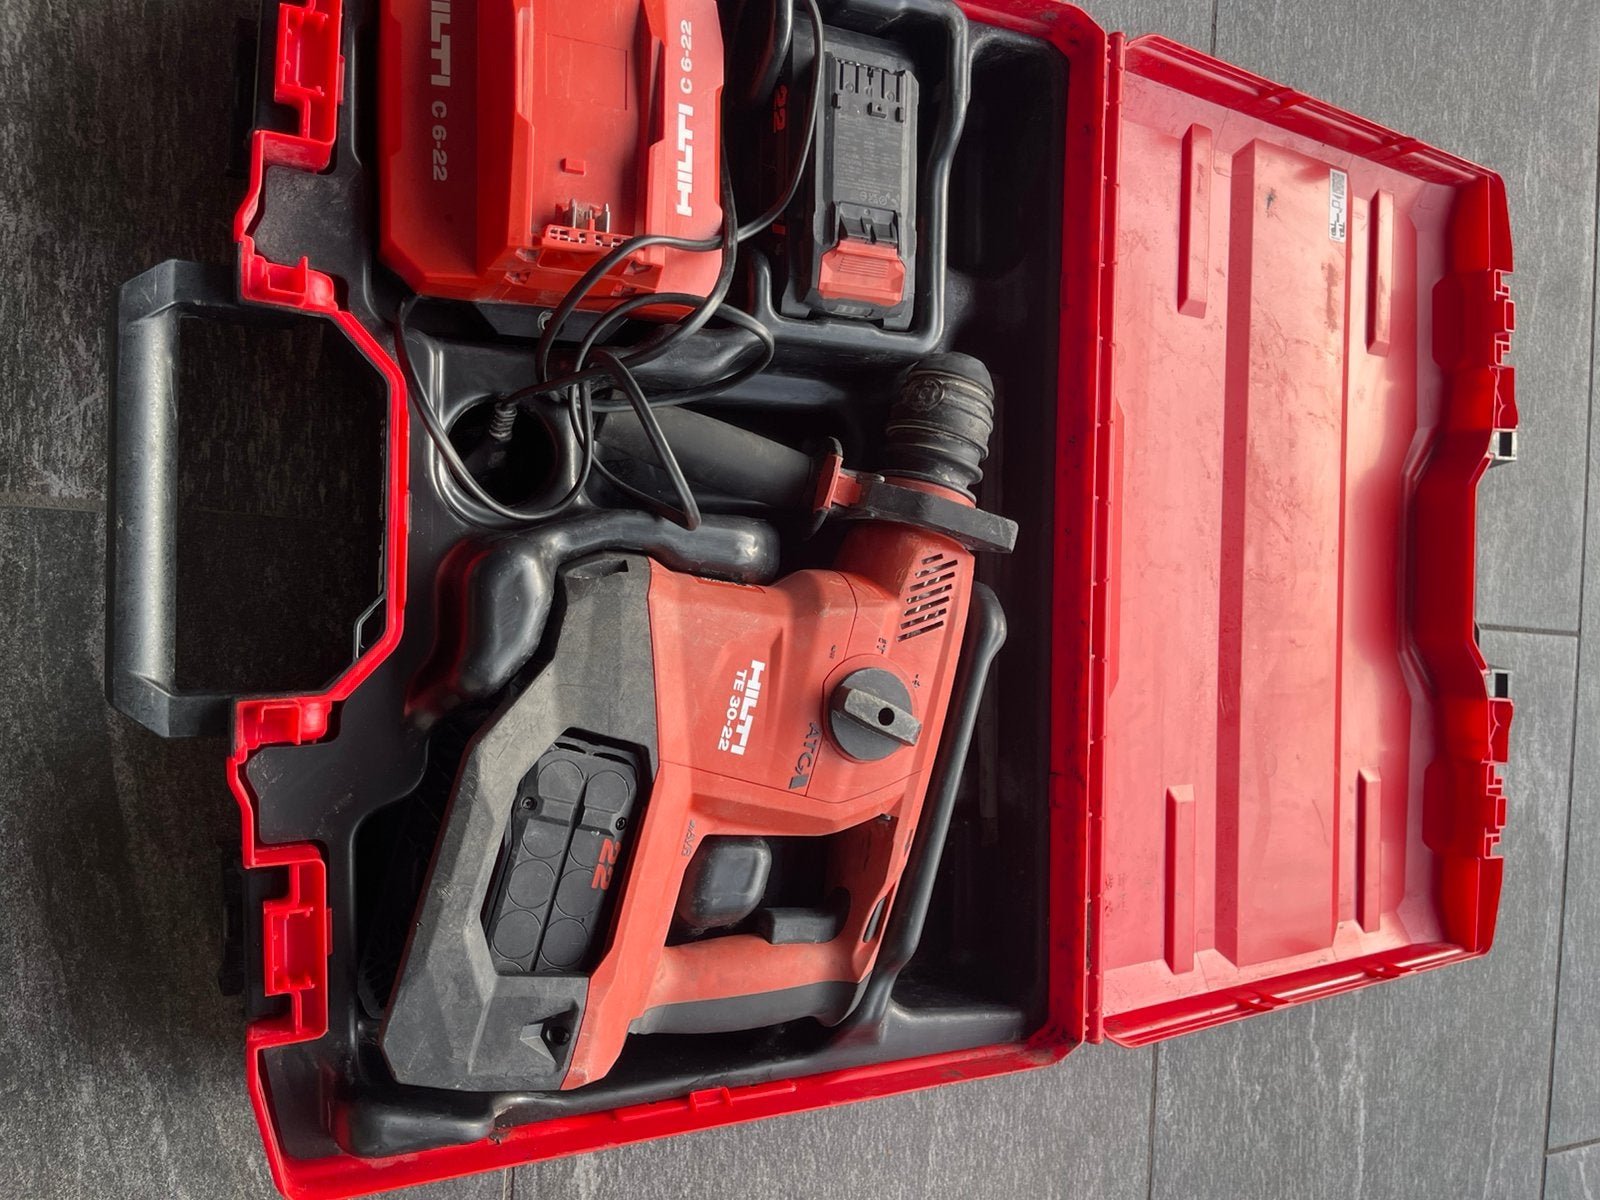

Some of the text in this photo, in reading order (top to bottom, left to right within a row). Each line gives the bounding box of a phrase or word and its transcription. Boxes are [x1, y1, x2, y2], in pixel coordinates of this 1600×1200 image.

[431, 0, 451, 182] ILTI C 6-22
[676, 19, 694, 217] HILTI C 6-22
[773, 85, 788, 132] 22
[717, 669, 748, 752] TE 30-22
[730, 659, 766, 756] HILTI
[795, 721, 821, 773] ATC
[591, 838, 621, 890] 22
